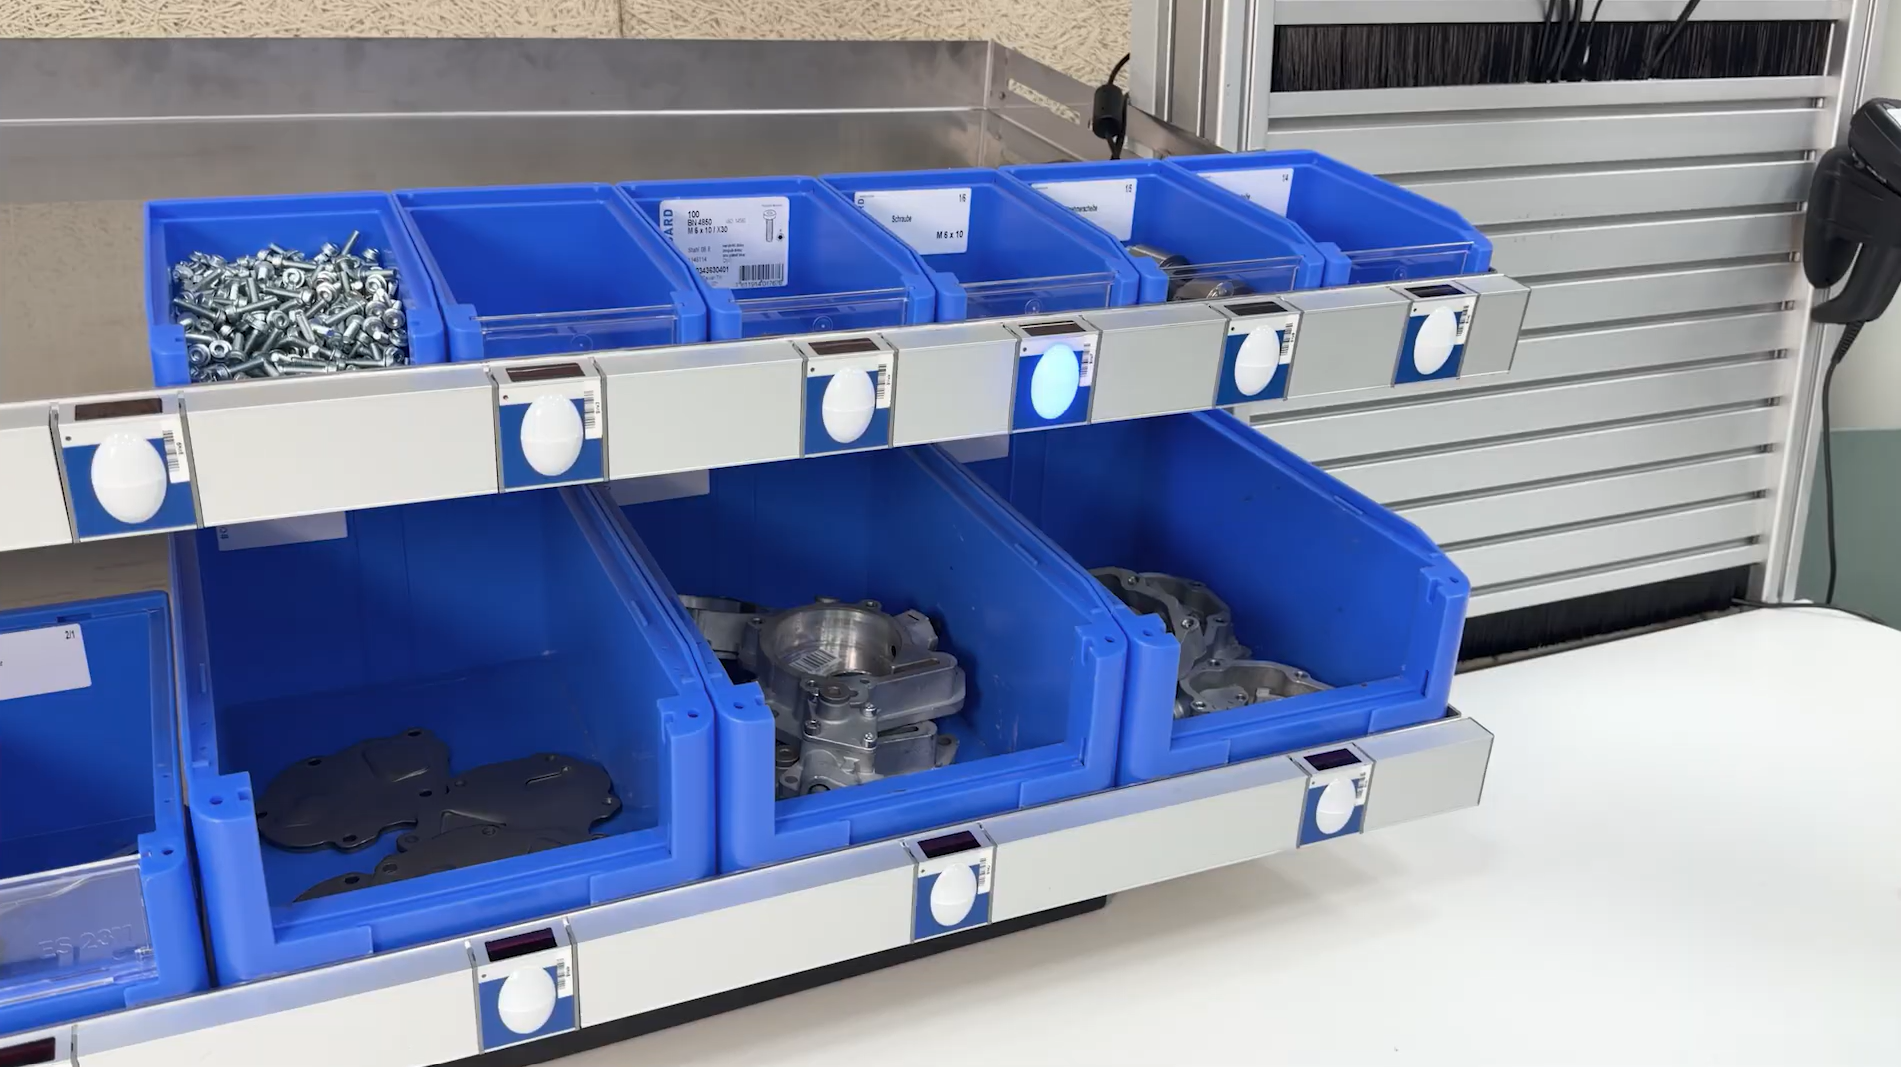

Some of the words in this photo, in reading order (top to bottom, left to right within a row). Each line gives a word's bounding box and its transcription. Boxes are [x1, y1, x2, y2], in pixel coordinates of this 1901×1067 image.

[688, 210, 700, 218] 100
[891, 215, 912, 223] Schraube
[936, 231, 943, 239] M
[956, 230, 963, 238] 10
[65, 630, 75, 640] 2/1
